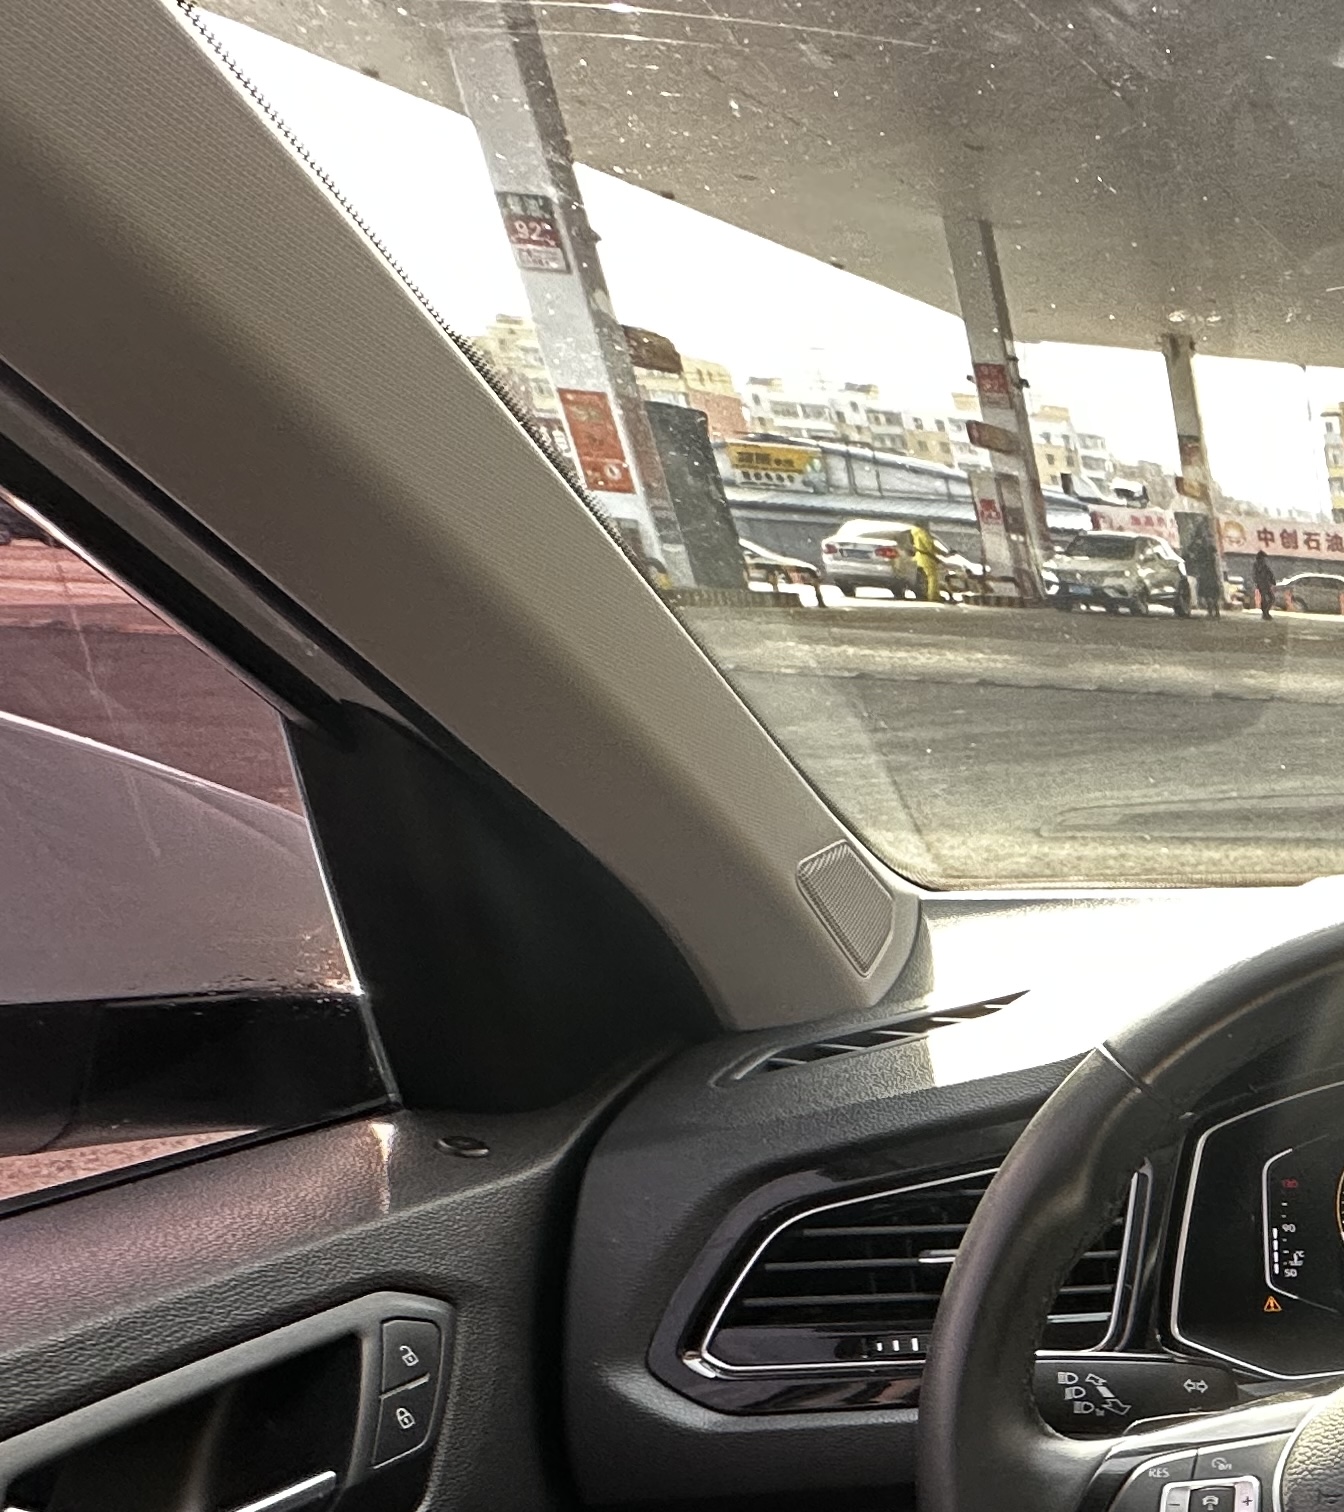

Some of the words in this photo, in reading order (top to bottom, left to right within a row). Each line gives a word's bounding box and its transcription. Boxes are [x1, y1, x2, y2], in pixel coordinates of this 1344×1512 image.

[1282, 1223, 1296, 1233] 90
[1284, 1268, 1298, 1278] 50
[1148, 1467, 1170, 1478] RES
